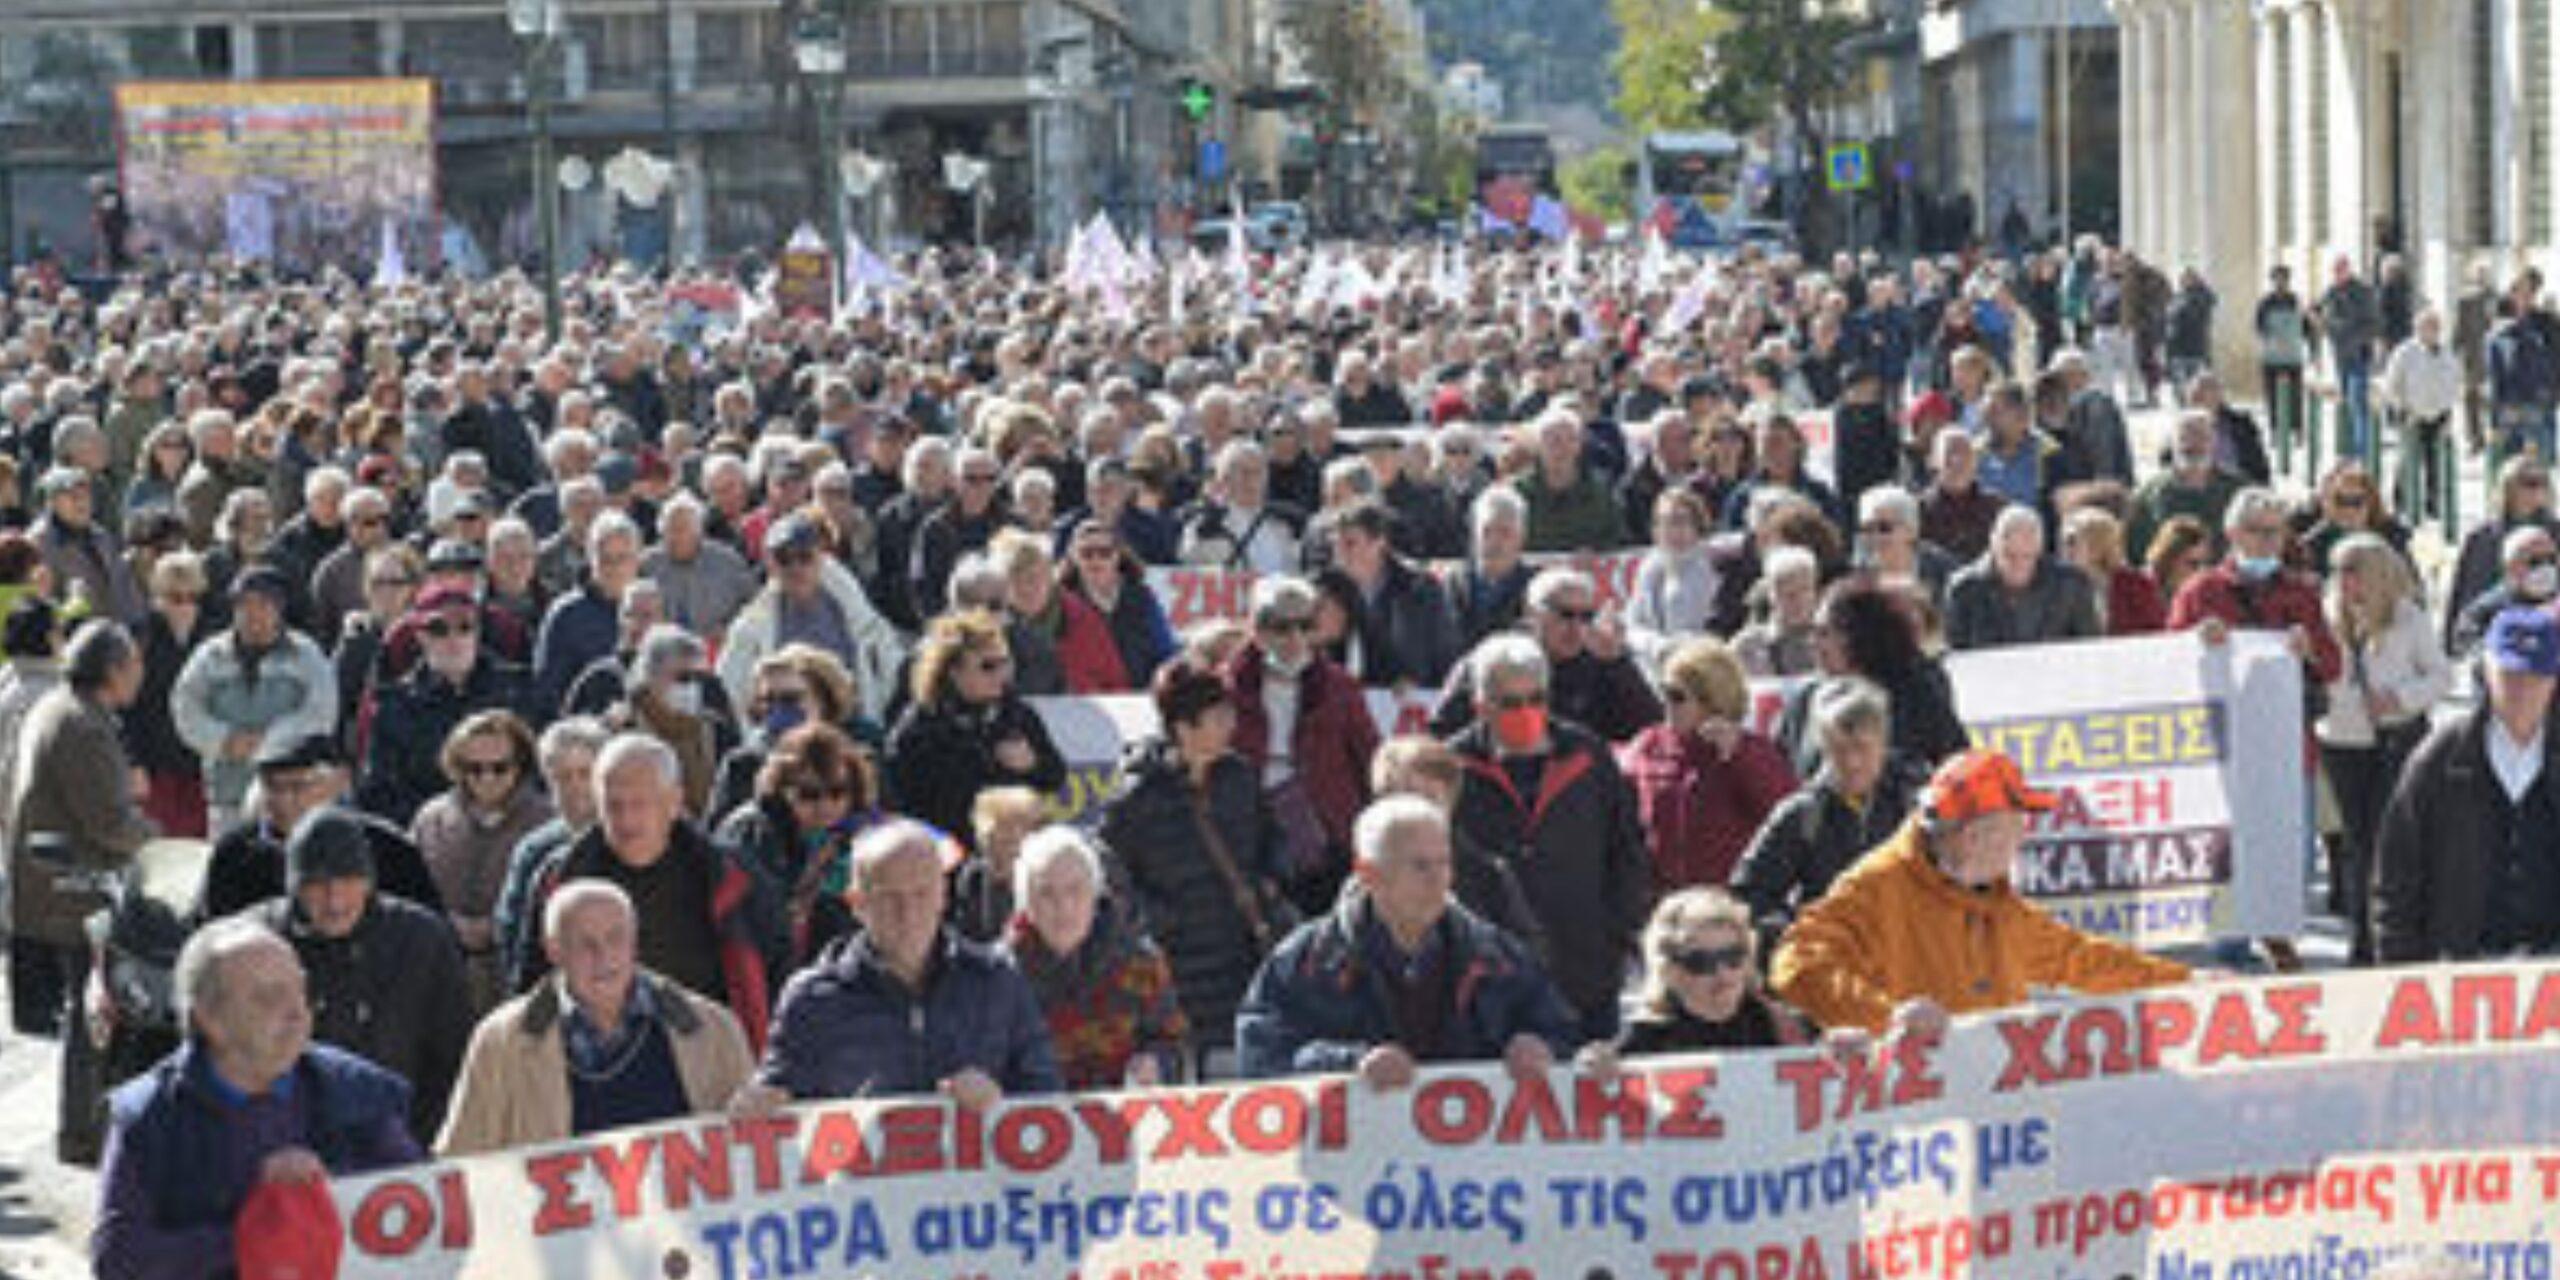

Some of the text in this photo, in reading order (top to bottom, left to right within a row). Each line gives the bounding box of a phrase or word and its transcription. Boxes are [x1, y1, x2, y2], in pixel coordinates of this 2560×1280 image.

[2023, 776, 2174, 833] ΑΞΗ
[2105, 830, 2214, 888] ΜΑΣ
[351, 1169, 475, 1257] ΟΙ
[525, 1079, 1349, 1237] ΣΥΝΤΑΞΙΟΥΧΟΙ
[1411, 1066, 1724, 1146] ΟΛΗΣ
[1776, 1024, 1944, 1132] ΤΗΣ
[1993, 982, 2327, 1093] ΧΩΡΑΣ
[702, 1116, 2051, 1280] ΤΩΡΑ αυξήσεις σε όλες τις συντάξεις με
[1847, 1210, 2012, 1280] μέτρα
[2033, 1157, 2395, 1257] προστασίας
[2418, 1157, 2512, 1224] για
